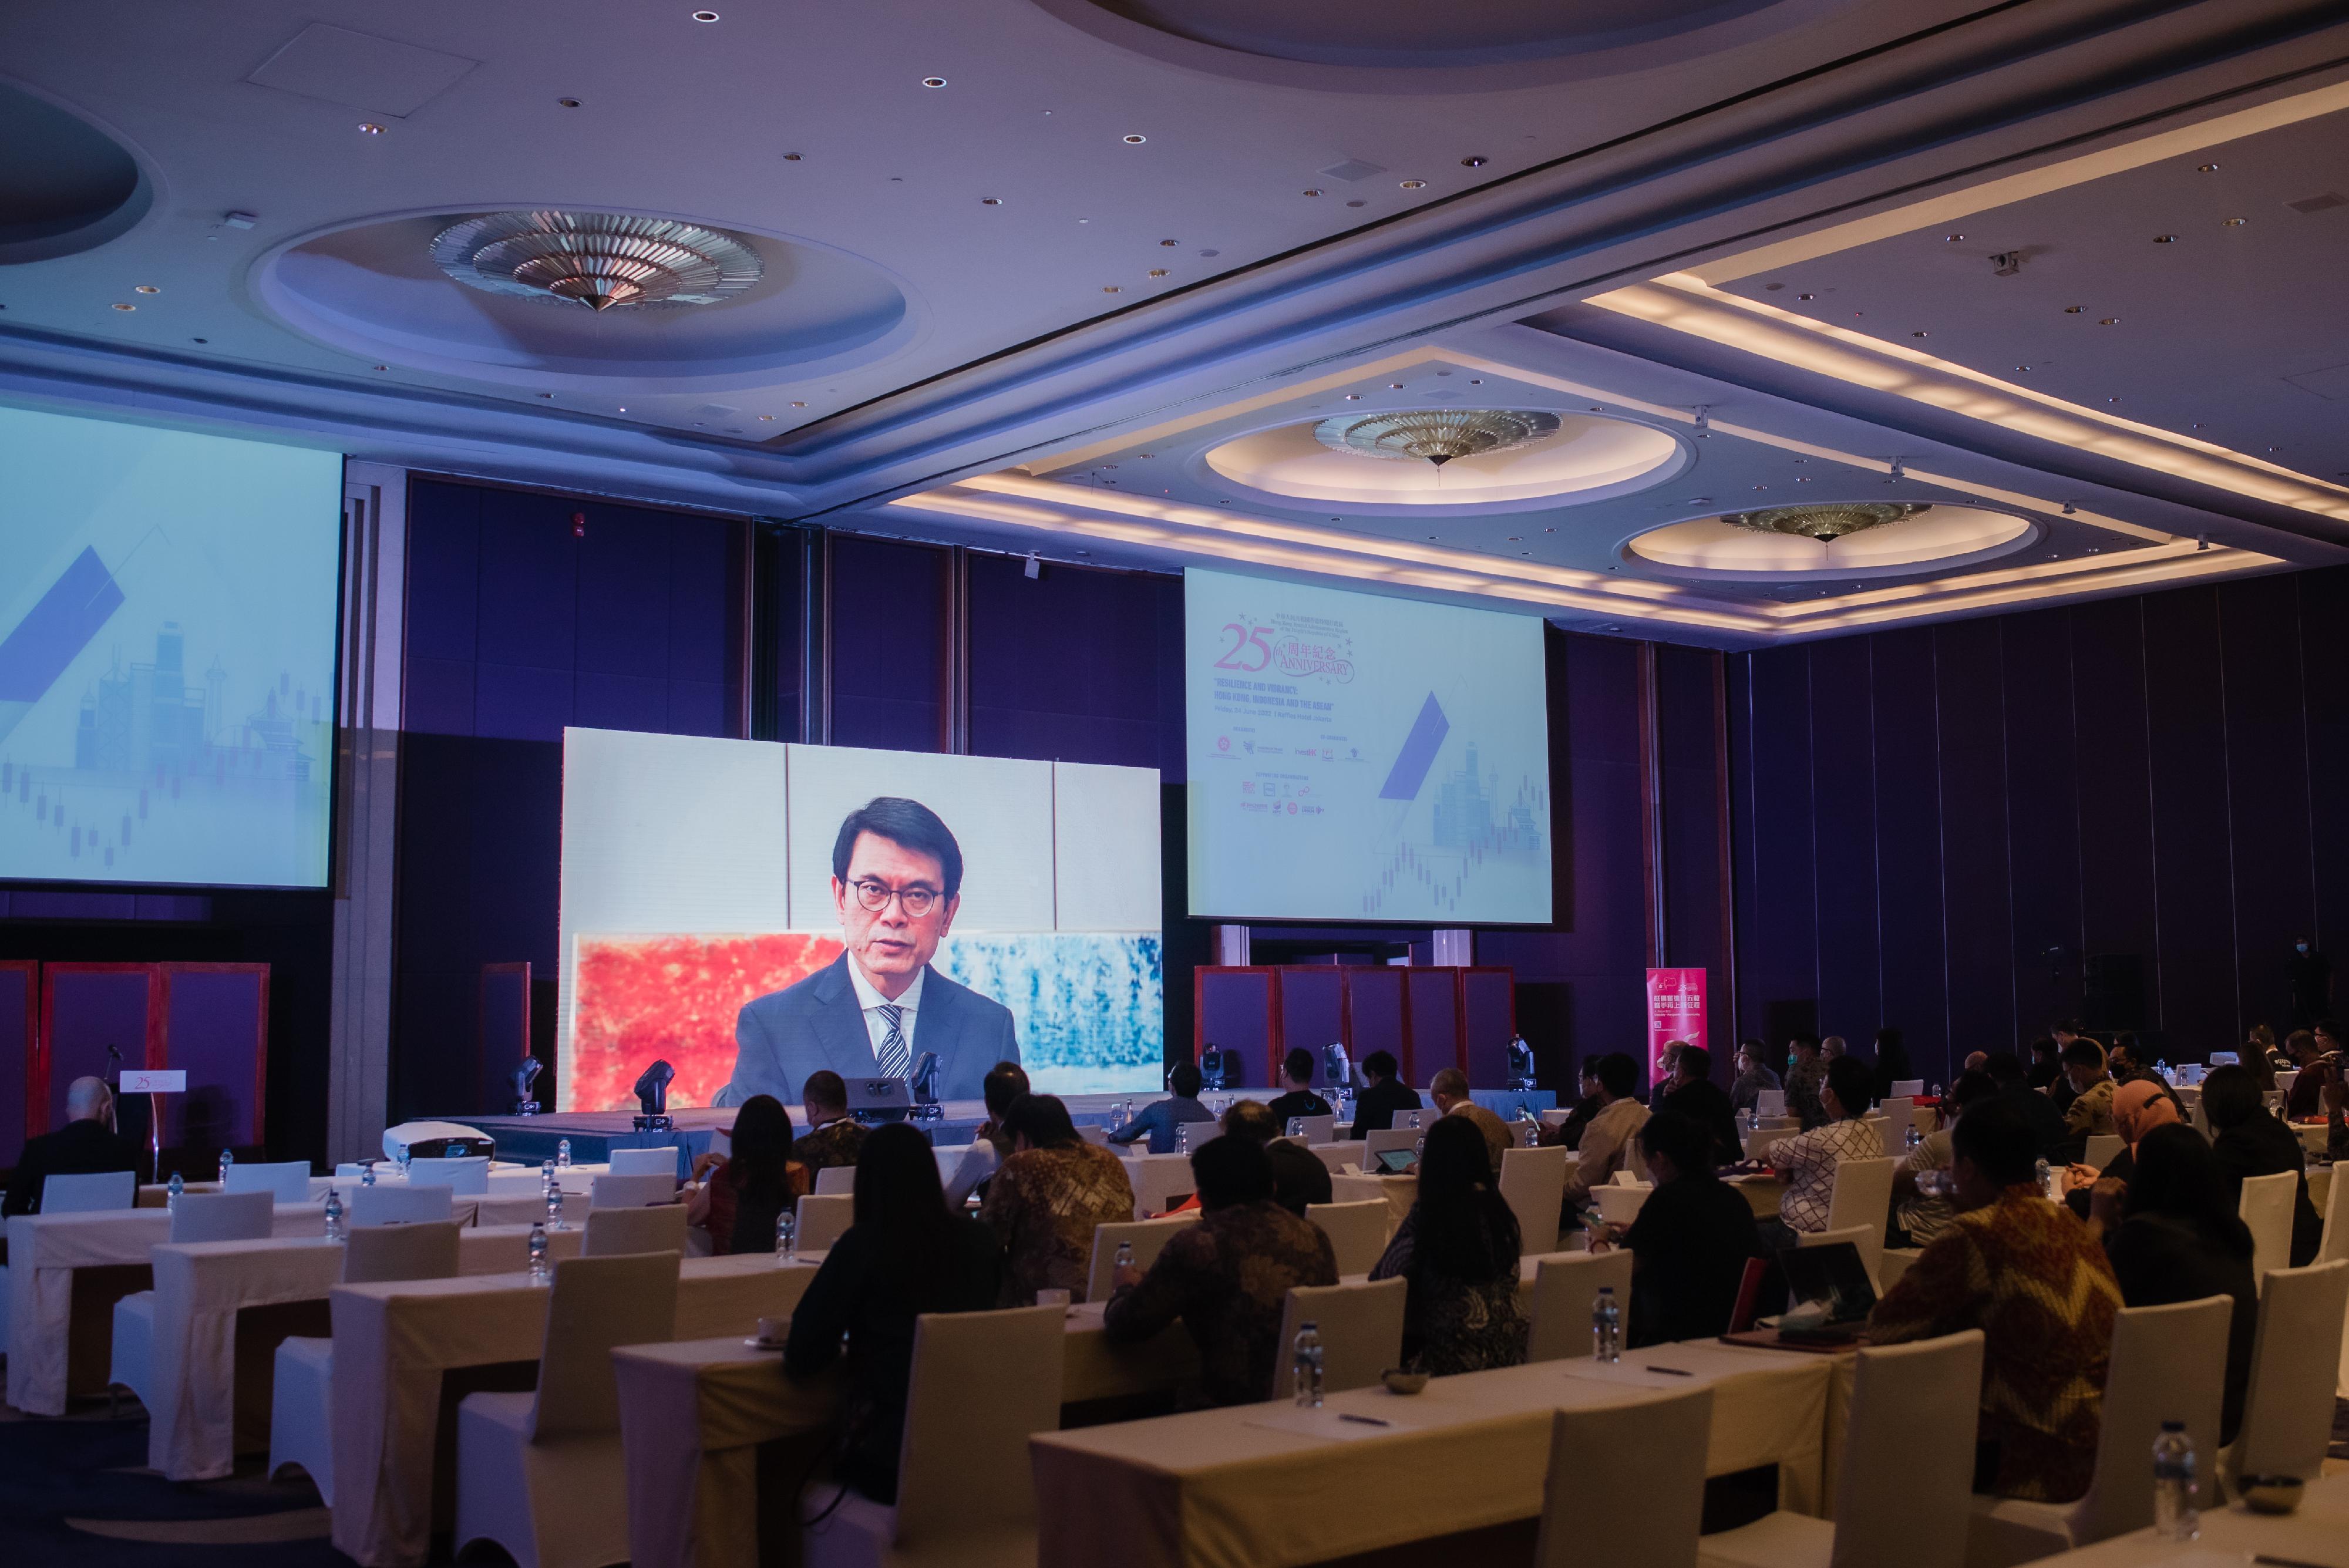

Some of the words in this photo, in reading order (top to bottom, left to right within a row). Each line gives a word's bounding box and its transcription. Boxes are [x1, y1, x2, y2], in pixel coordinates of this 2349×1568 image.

[1213, 623, 1274, 672] 25
[1288, 642, 1336, 660] 周年紀念
[1253, 682, 1266, 691] AND
[1214, 691, 1231, 701] HONG
[1233, 693, 1251, 704] KONG,
[1253, 695, 1285, 706] INDONESIA
[1286, 699, 1299, 708] AND
[1300, 700, 1311, 709] THE
[134, 1076, 151, 1089] 25
